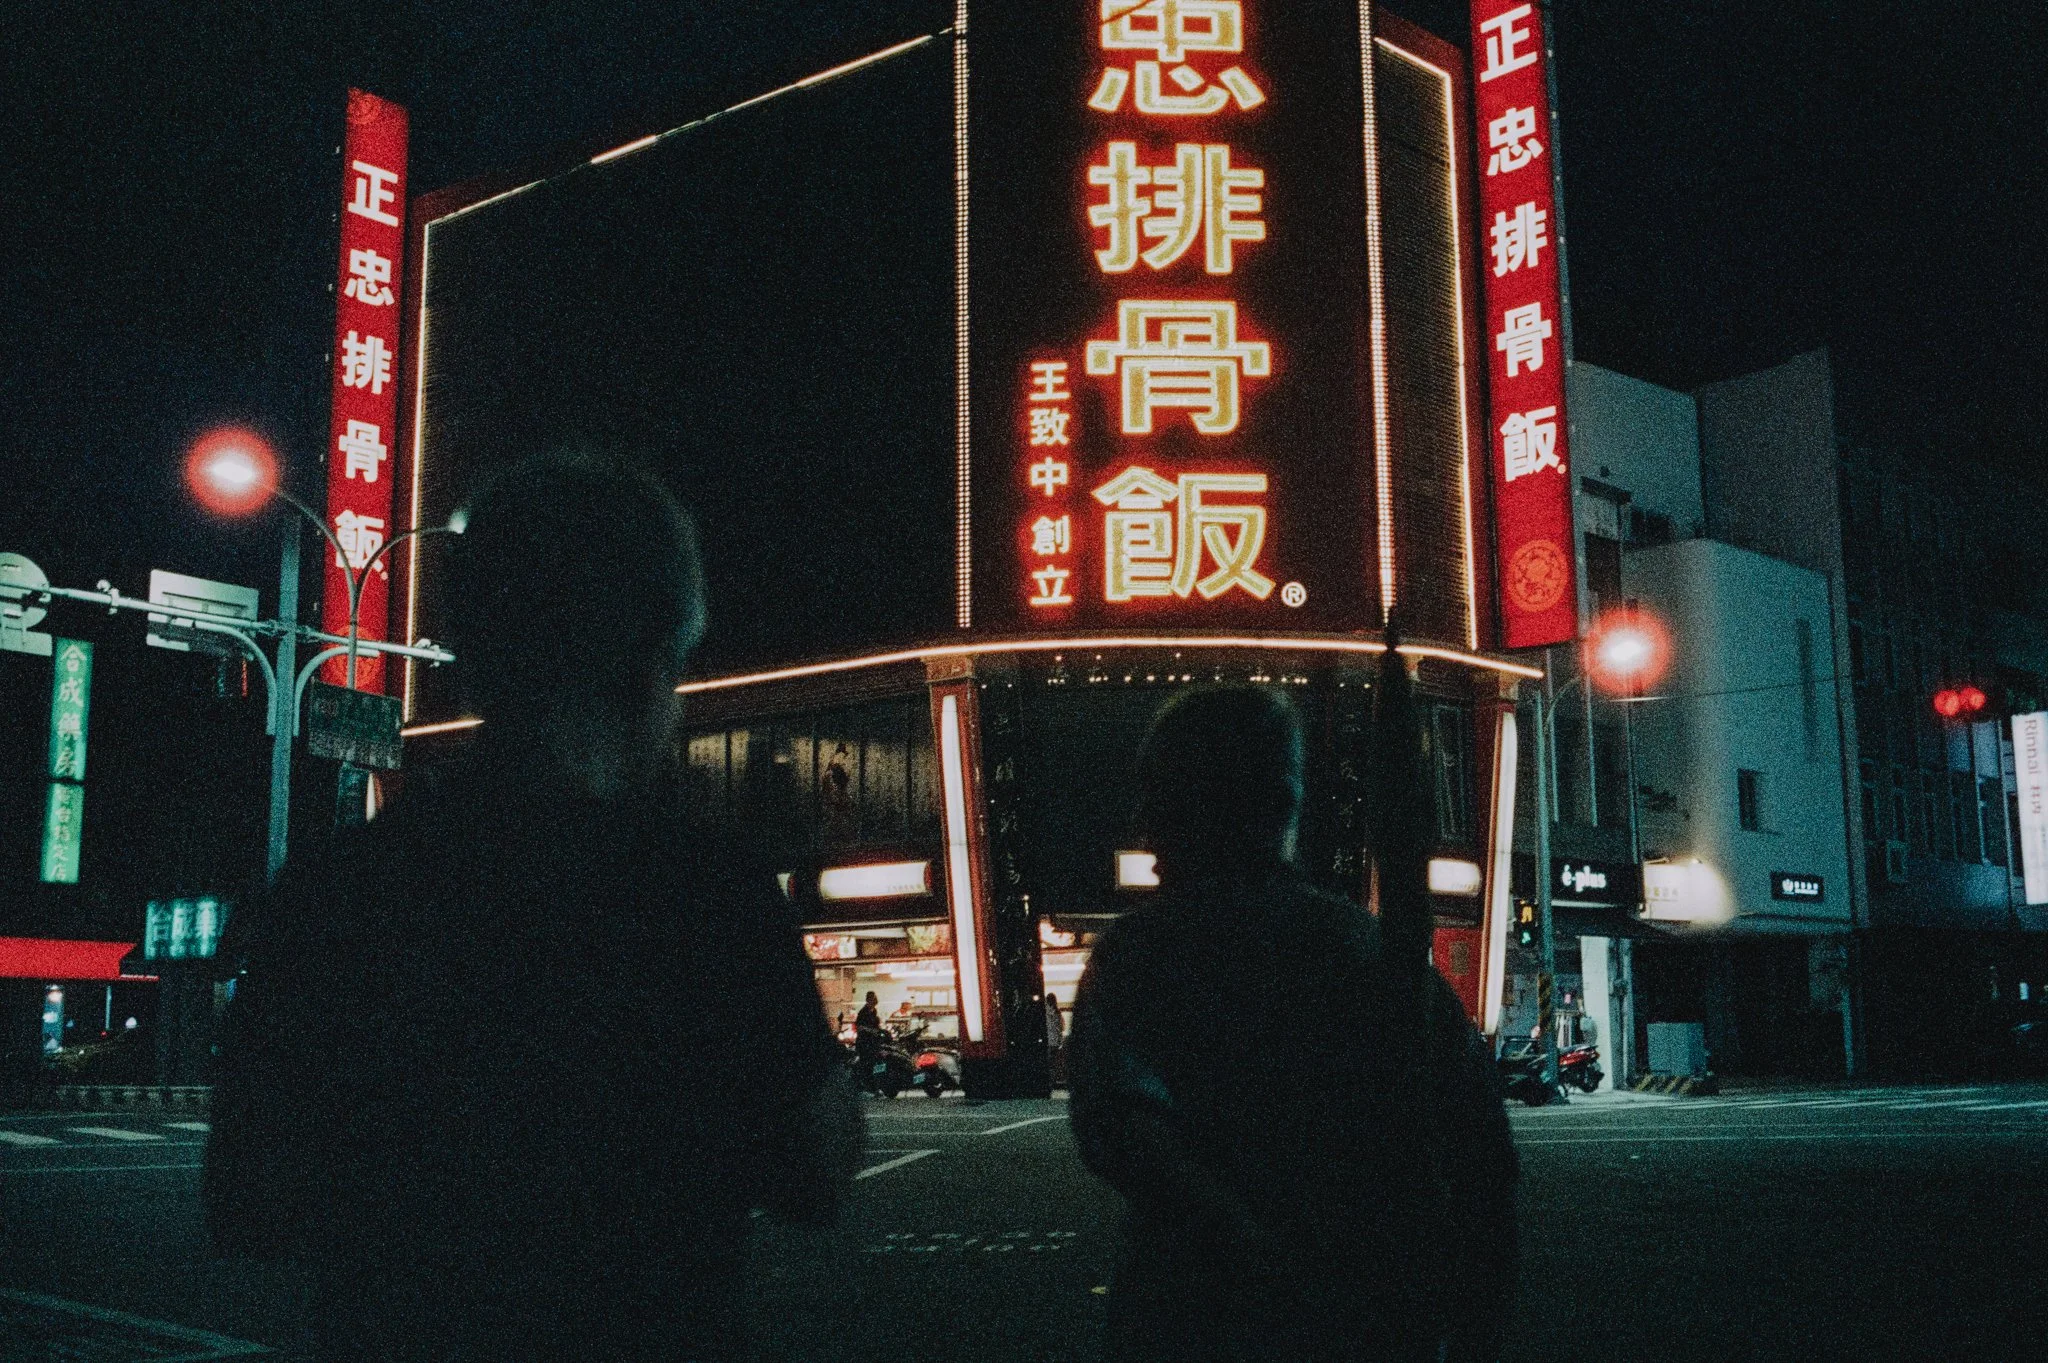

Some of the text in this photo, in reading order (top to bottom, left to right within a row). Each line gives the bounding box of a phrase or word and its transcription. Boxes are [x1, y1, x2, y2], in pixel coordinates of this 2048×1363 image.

[334, 160, 398, 573] 正忠排骨飯
[1480, 3, 1560, 482] 正忠排骨飯
[1029, 361, 1073, 607] 王致中創立
[2025, 719, 2041, 776] Rinnai
